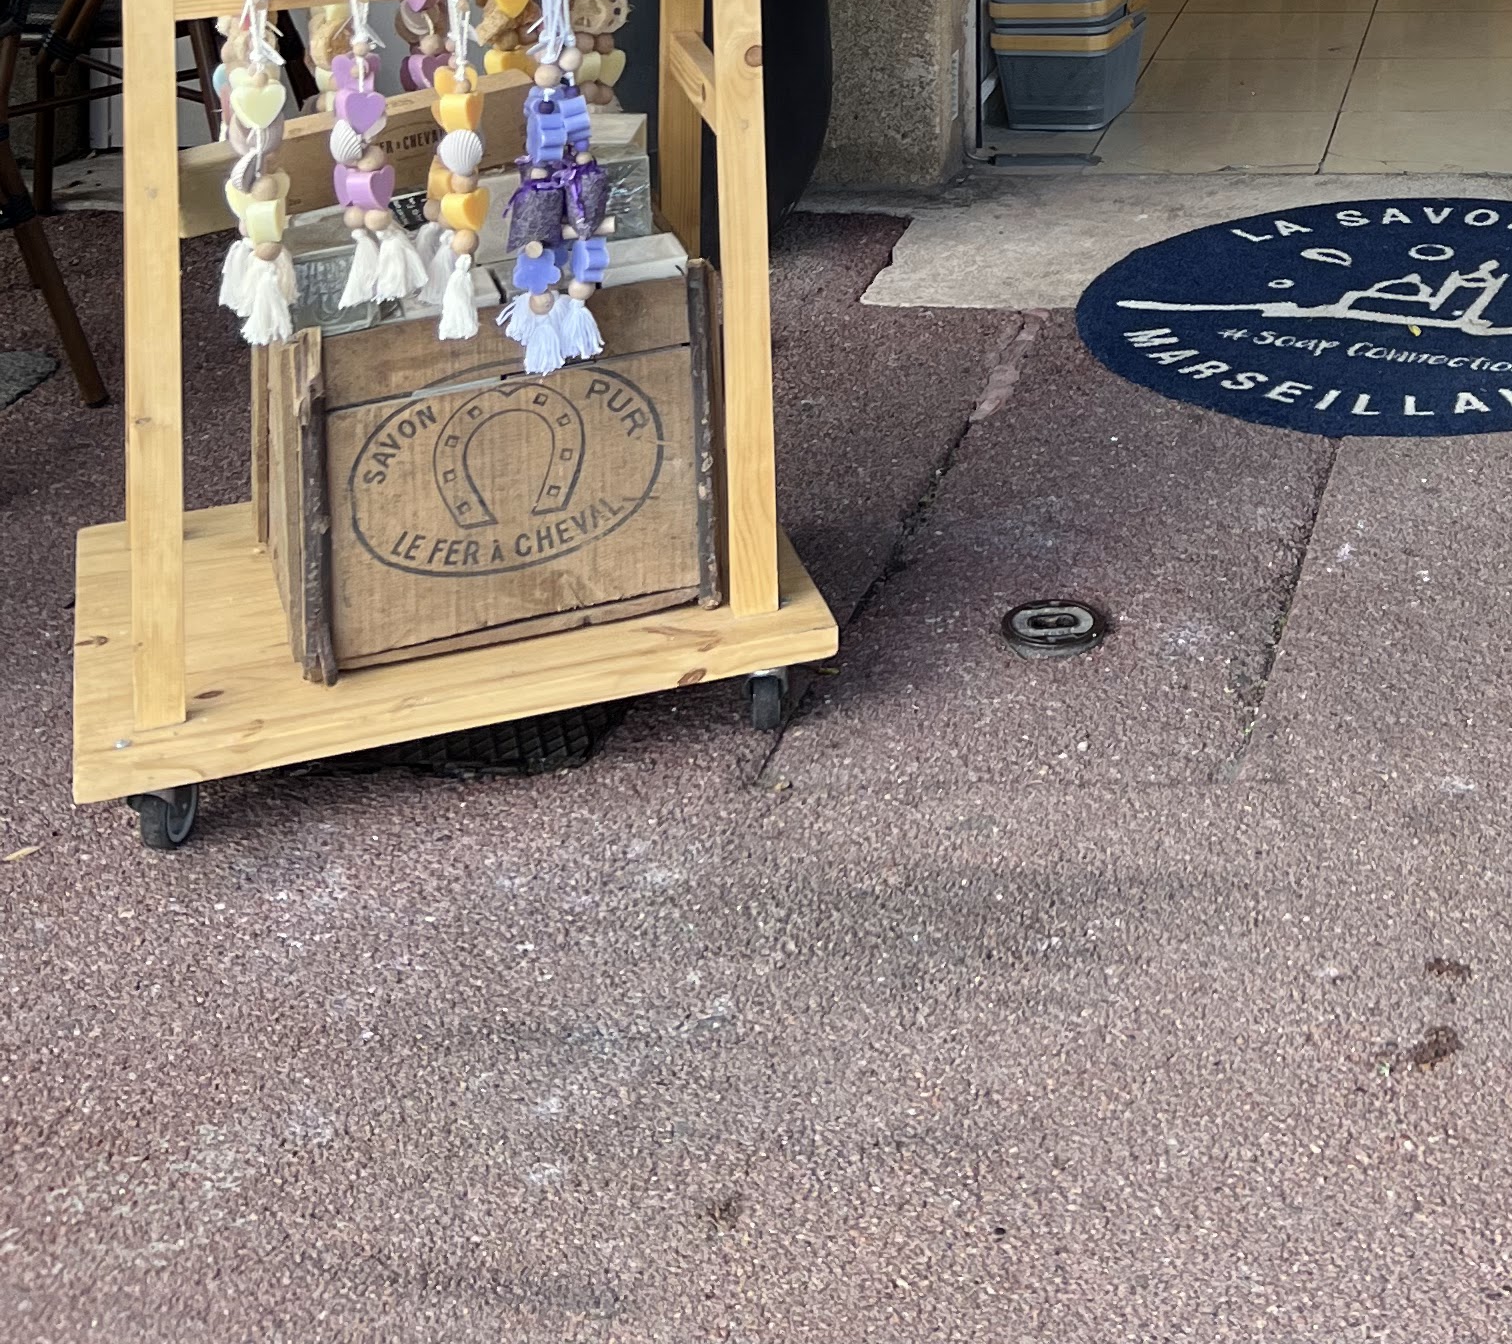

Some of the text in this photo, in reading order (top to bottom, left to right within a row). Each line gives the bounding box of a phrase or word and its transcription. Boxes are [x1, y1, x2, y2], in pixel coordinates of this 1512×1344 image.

[1231, 217, 1314, 244] LA
[362, 378, 651, 486] SAVON PUR
[390, 530, 426, 561] LE
[427, 539, 480, 566] FER
[515, 496, 625, 558] CHEVAL
